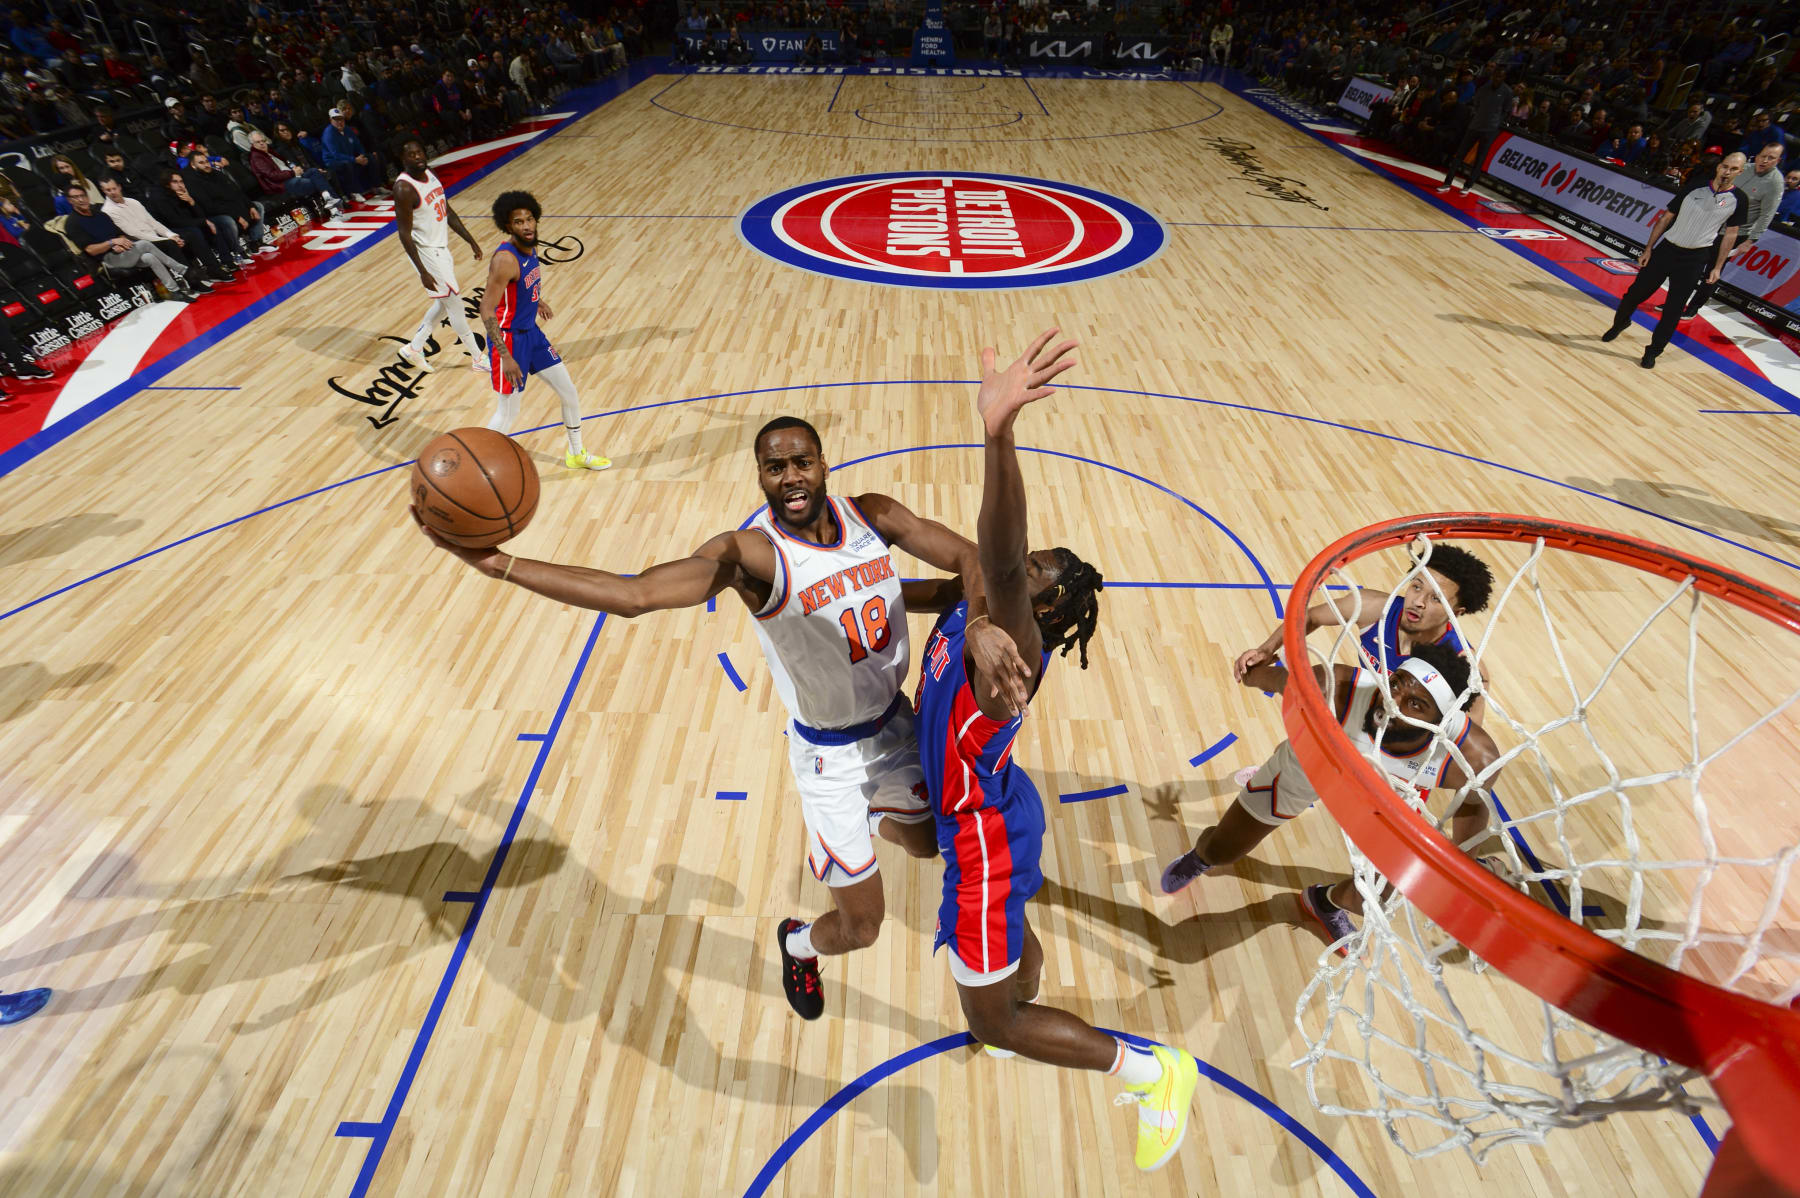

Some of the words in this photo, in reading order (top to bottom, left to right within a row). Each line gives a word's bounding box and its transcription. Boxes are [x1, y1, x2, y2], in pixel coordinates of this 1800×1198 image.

[779, 39, 836, 50] FANEL
[870, 67, 1023, 76] PISTONS
[886, 188, 951, 258] PISTONS
[954, 189, 1026, 258] DETROIT
[1497, 148, 1549, 180] BELFOR
[1568, 175, 1657, 223] PROPERTY
[1728, 245, 1790, 279] ION
[97, 292, 124, 310] Little
[99, 300, 132, 320] Caesars
[65, 311, 94, 329] Little
[68, 318, 104, 339] Caesars
[29, 327, 60, 345] Little
[32, 334, 71, 357] Caesars
[798, 570, 846, 617] NEW
[843, 554, 895, 592] YORK
[839, 595, 891, 664] 18
